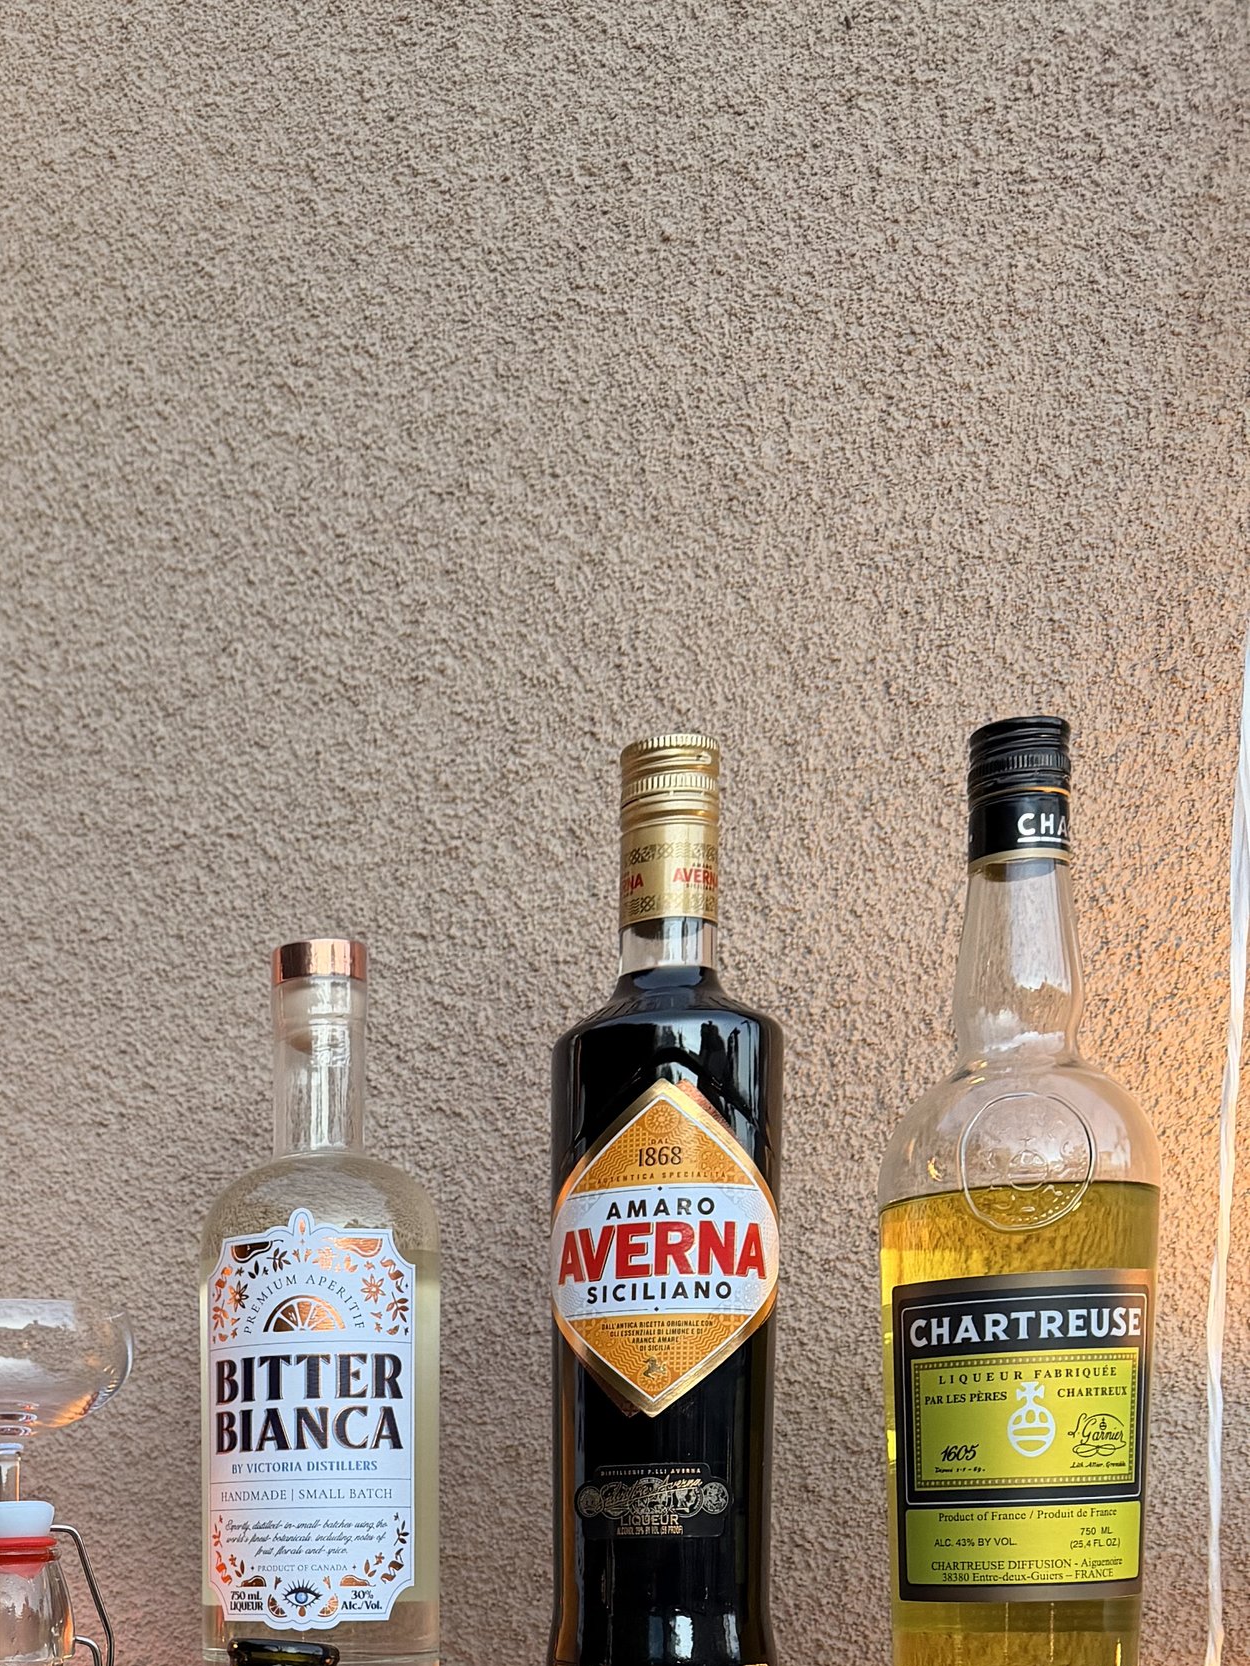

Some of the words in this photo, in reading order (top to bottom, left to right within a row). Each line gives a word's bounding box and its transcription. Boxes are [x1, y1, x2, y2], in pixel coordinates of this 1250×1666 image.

[1017, 812, 1069, 838] CHA
[672, 867, 718, 888] AVERN
[638, 1146, 682, 1167] 1868
[606, 1197, 715, 1221] AMARO
[558, 1220, 767, 1286] AVERNA
[587, 1280, 732, 1305] SICILIANO
[243, 1273, 298, 1335] PREMIUM
[305, 1273, 366, 1330] APERITIF
[909, 1307, 1142, 1348] CHARTREUSE
[215, 1352, 404, 1405] BITTER
[938, 1370, 1023, 1385] LIQUEUR
[1034, 1364, 1117, 1379] FABRIQUÉE
[924, 1394, 943, 1406] PAR
[946, 1393, 966, 1404] LES
[969, 1389, 1008, 1403] PÈRES
[1057, 1385, 1128, 1398] CHARTREUX
[215, 1406, 404, 1455] BIANCA
[941, 1443, 979, 1462] 1605
[231, 1463, 244, 1474] BY
[246, 1462, 303, 1474] VICTORIA
[306, 1460, 378, 1472] DISTILLERS
[221, 1489, 287, 1502] HANDMADE
[298, 1488, 346, 1500] SMALL
[349, 1488, 393, 1500] BATCH
[620, 1514, 679, 1526] LIQUEUR
[938, 1511, 974, 1522] Product
[976, 1510, 989, 1521] of
[991, 1511, 1027, 1521] France
[1037, 1508, 1075, 1519] Produit
[1076, 1508, 1088, 1518] de
[1090, 1507, 1118, 1518] France
[1080, 1527, 1097, 1536] 750
[1100, 1526, 1113, 1535] ML
[934, 1538, 953, 1547] ALC.
[955, 1538, 975, 1547] 43%
[977, 1537, 992, 1547] BY
[993, 1537, 1018, 1546] VOL.
[257, 1564, 295, 1572] PRODUCT
[297, 1564, 309, 1572] OF
[310, 1564, 348, 1572] CANADA
[931, 1560, 1005, 1571] CHARTREUSE
[1007, 1558, 1072, 1570] DIFFUSION
[942, 1572, 970, 1582] 38380
[972, 1570, 1064, 1582] Entre-deux-Guiers
[1074, 1569, 1114, 1580] FRANCE
[230, 1591, 246, 1601] 750
[247, 1590, 263, 1600] mL
[351, 1590, 374, 1600] 30%
[230, 1601, 264, 1611] LIQUEUR
[341, 1600, 383, 1611] Alc./Vol.
